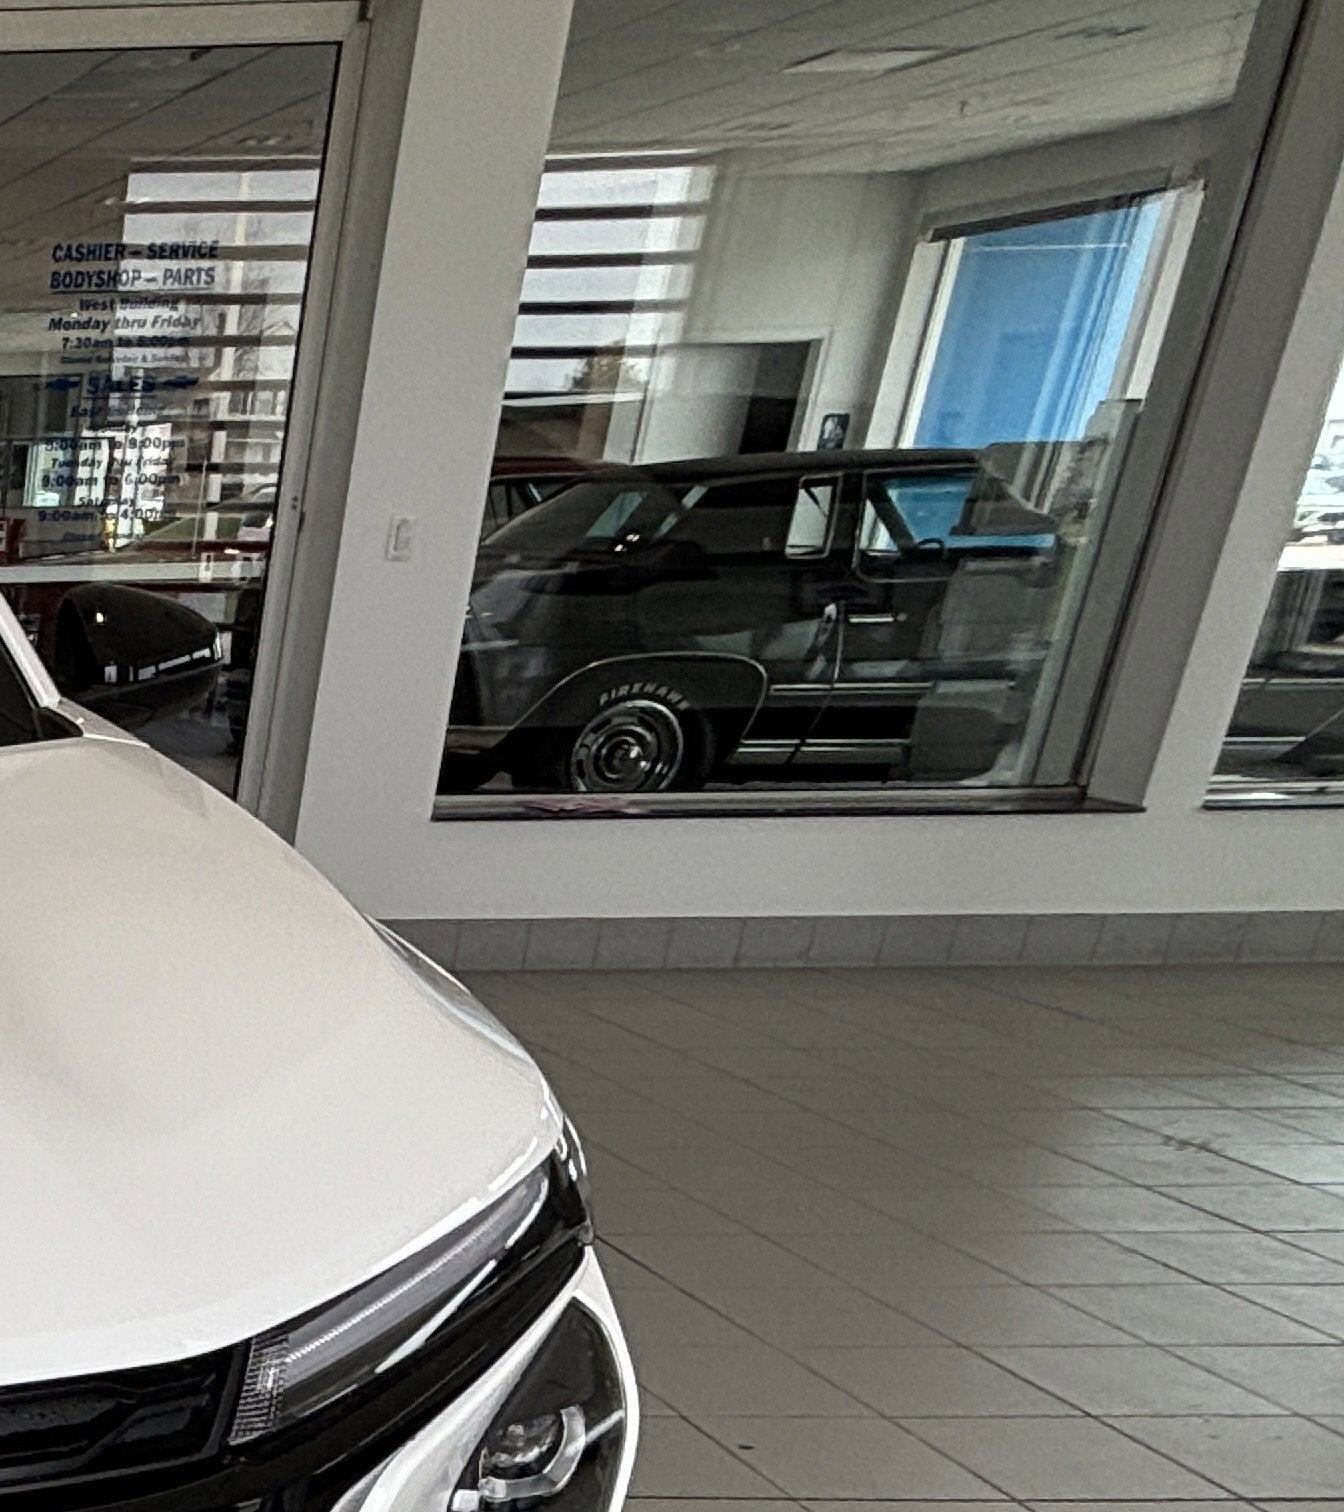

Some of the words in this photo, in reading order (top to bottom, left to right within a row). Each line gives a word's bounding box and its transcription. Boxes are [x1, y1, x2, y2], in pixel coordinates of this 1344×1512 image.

[52, 242, 126, 263] CASHIER
[146, 240, 220, 260] SERVICE
[50, 269, 142, 290] BODYSHOP
[162, 266, 216, 286] PARTS
[79, 298, 114, 311] West
[48, 316, 111, 333] Monday
[116, 316, 148, 329] thru
[151, 314, 202, 331] Friday
